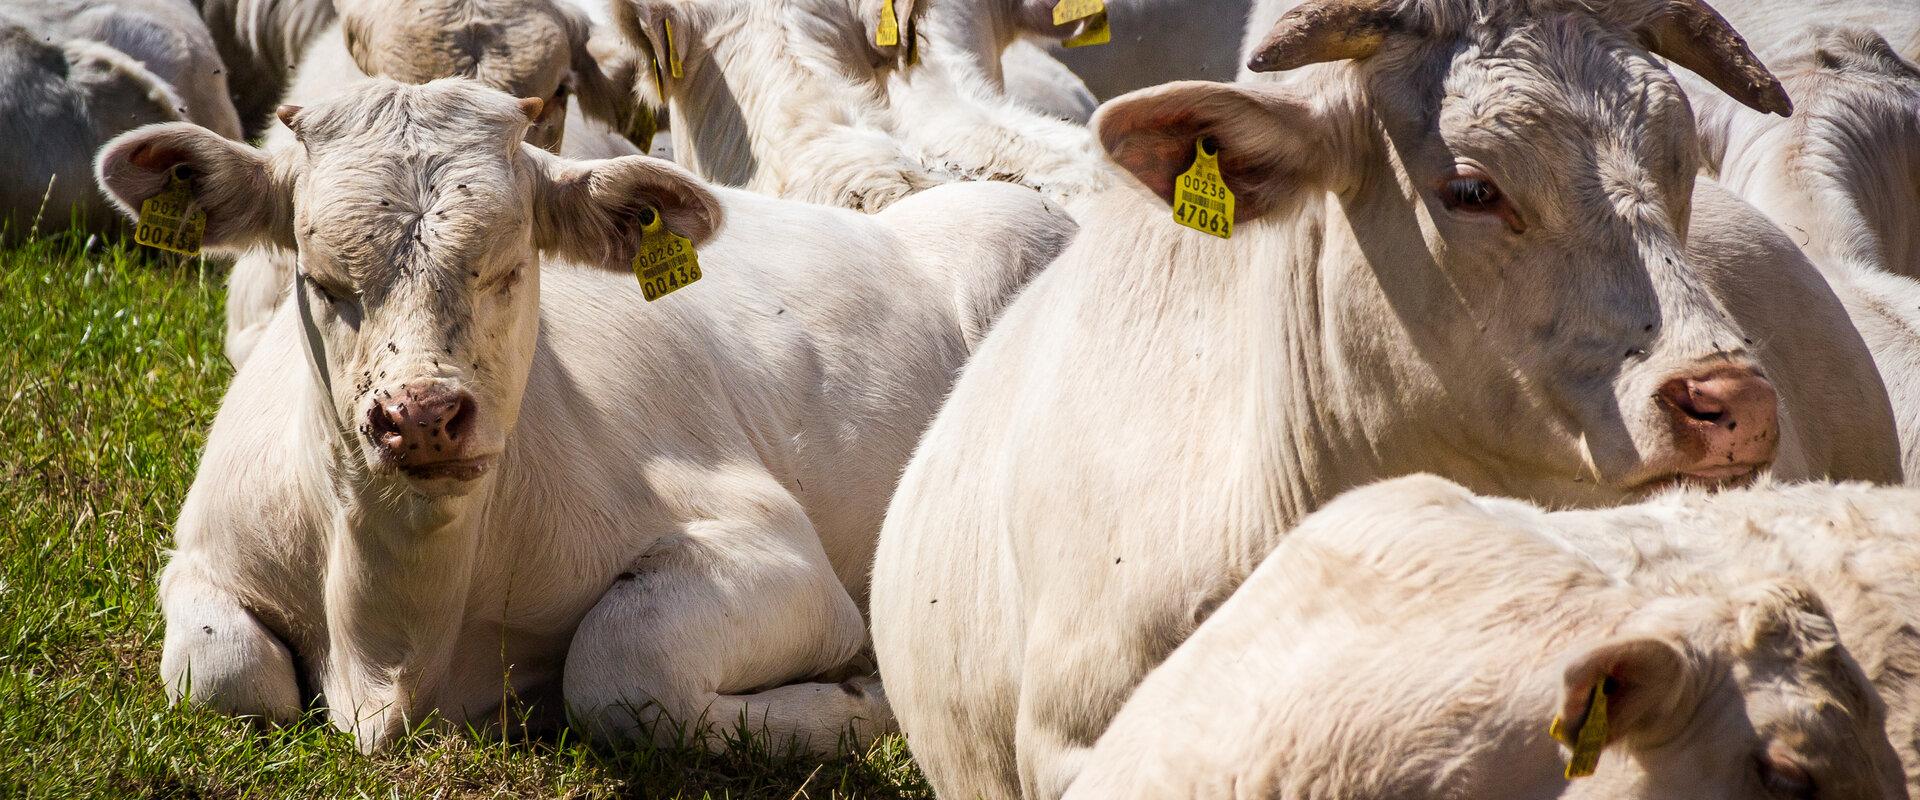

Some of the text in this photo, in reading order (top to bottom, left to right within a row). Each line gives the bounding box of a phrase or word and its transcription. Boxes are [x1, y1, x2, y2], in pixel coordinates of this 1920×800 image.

[1184, 175, 1226, 200] 00238
[639, 240, 683, 268] 00263
[644, 265, 698, 299] 00436
